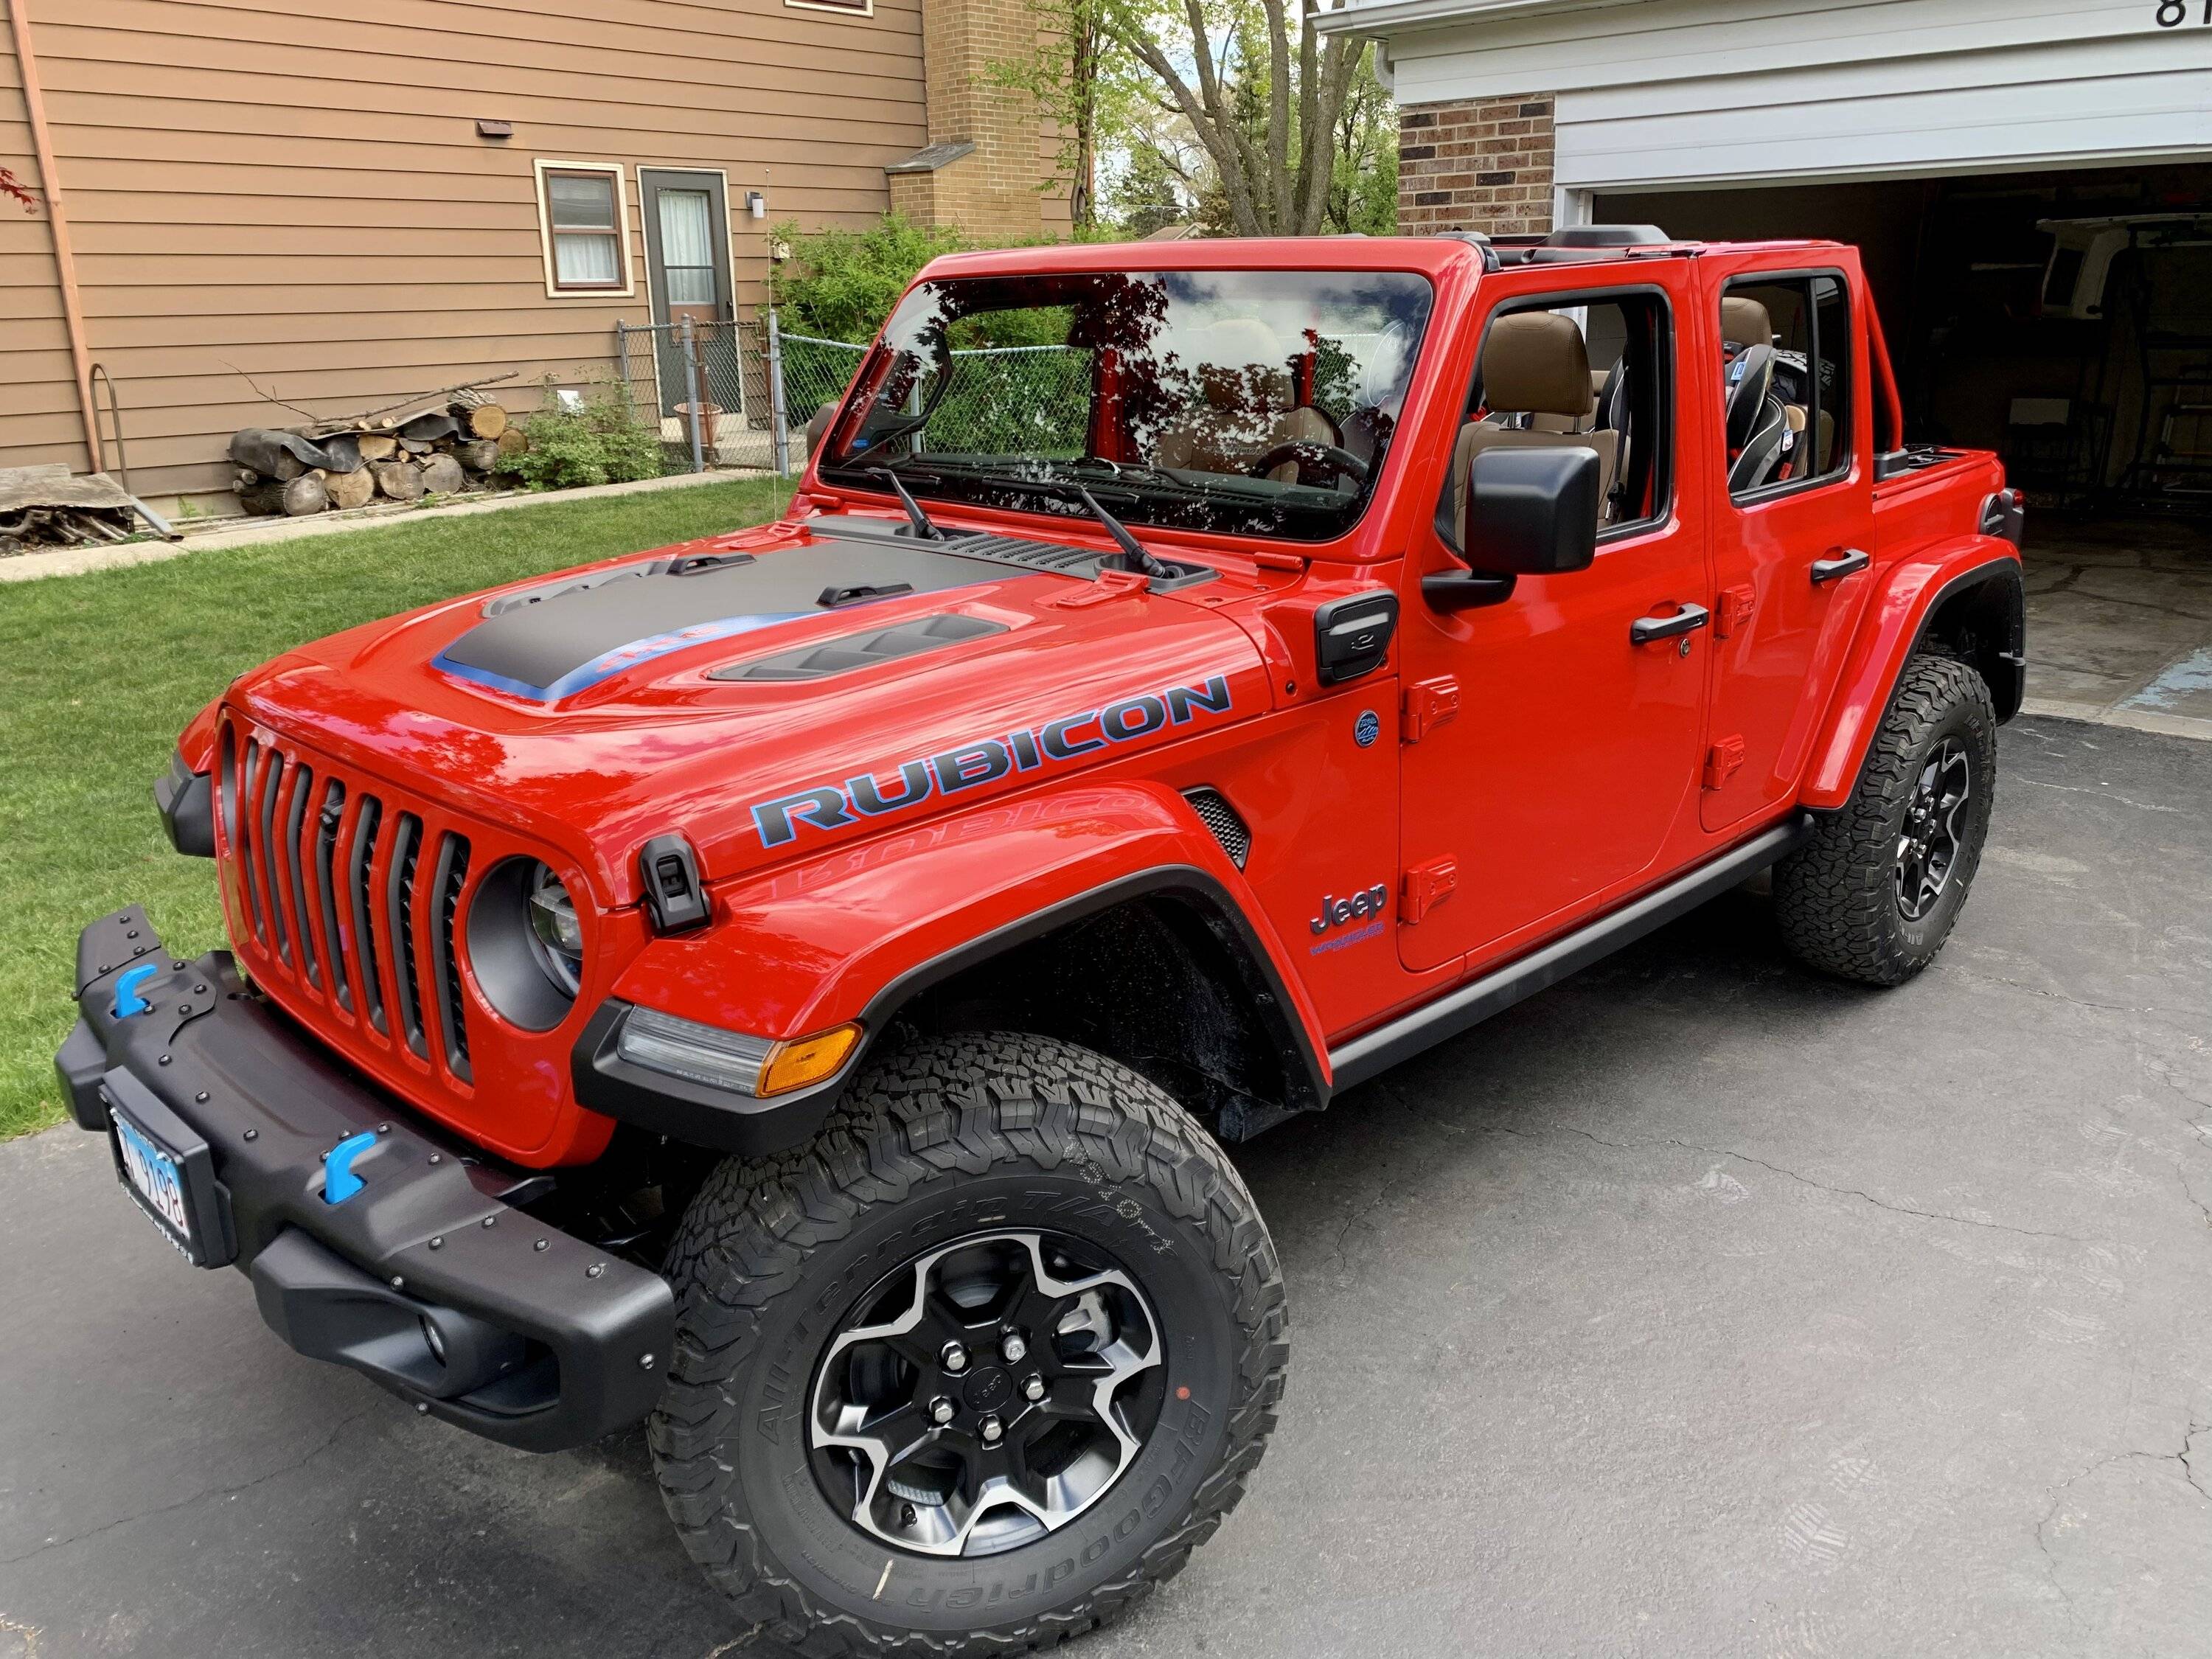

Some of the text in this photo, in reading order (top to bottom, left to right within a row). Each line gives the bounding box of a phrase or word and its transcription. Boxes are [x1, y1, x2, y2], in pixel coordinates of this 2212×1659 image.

[749, 673, 1233, 849] RUBICON
[1310, 883, 1388, 935] Jeep
[906, 1399, 1211, 1613] BFGoodrich
